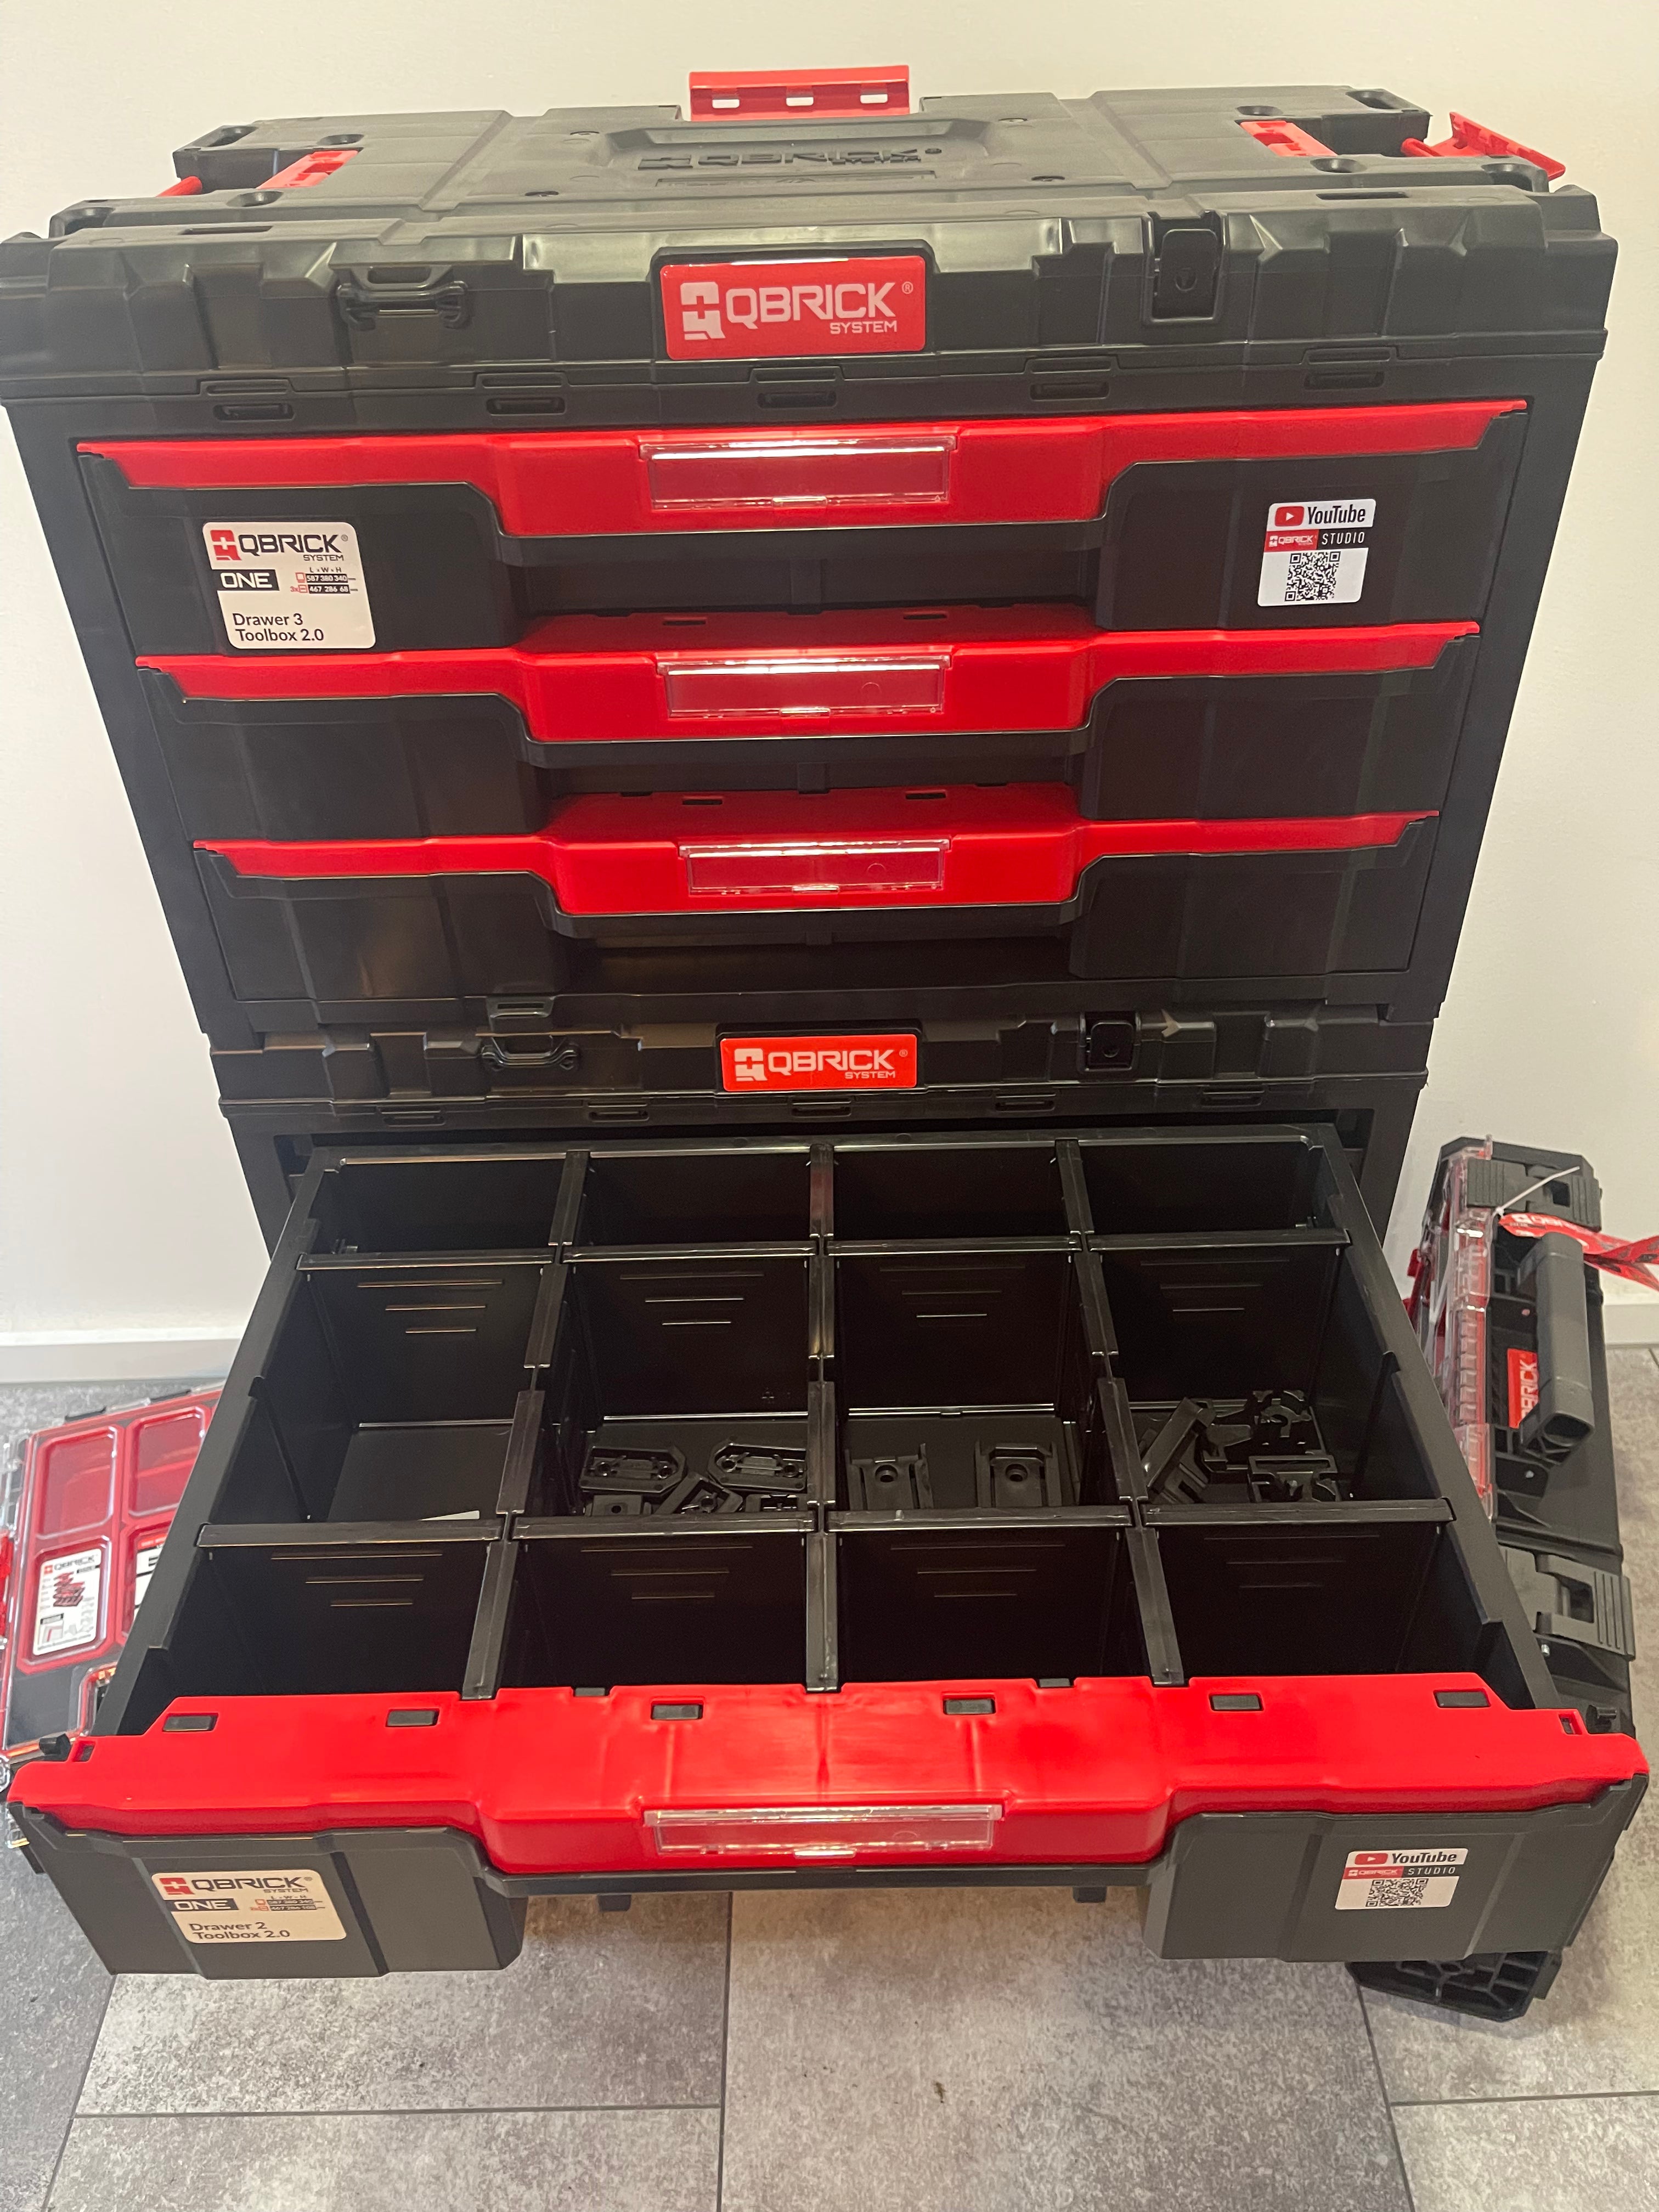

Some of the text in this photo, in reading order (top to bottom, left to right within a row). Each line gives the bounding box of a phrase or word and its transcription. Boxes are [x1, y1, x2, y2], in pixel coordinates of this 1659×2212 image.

[830, 320, 898, 335] SYSTEM
[1308, 504, 1366, 525] YouTube
[1321, 531, 1365, 545] STUDIO
[220, 572, 273, 588] ONE
[232, 613, 303, 625] Drawer 3
[235, 629, 324, 641] Toolbox 2.0
[845, 1071, 896, 1079] SYSTEM
[1392, 1851, 1457, 1864] YouTube
[1408, 1866, 1455, 1875] STUDIO
[173, 1900, 231, 1910] ONE
[189, 1923, 252, 1931] Drawer
[264, 1929, 290, 1938] 2.0
